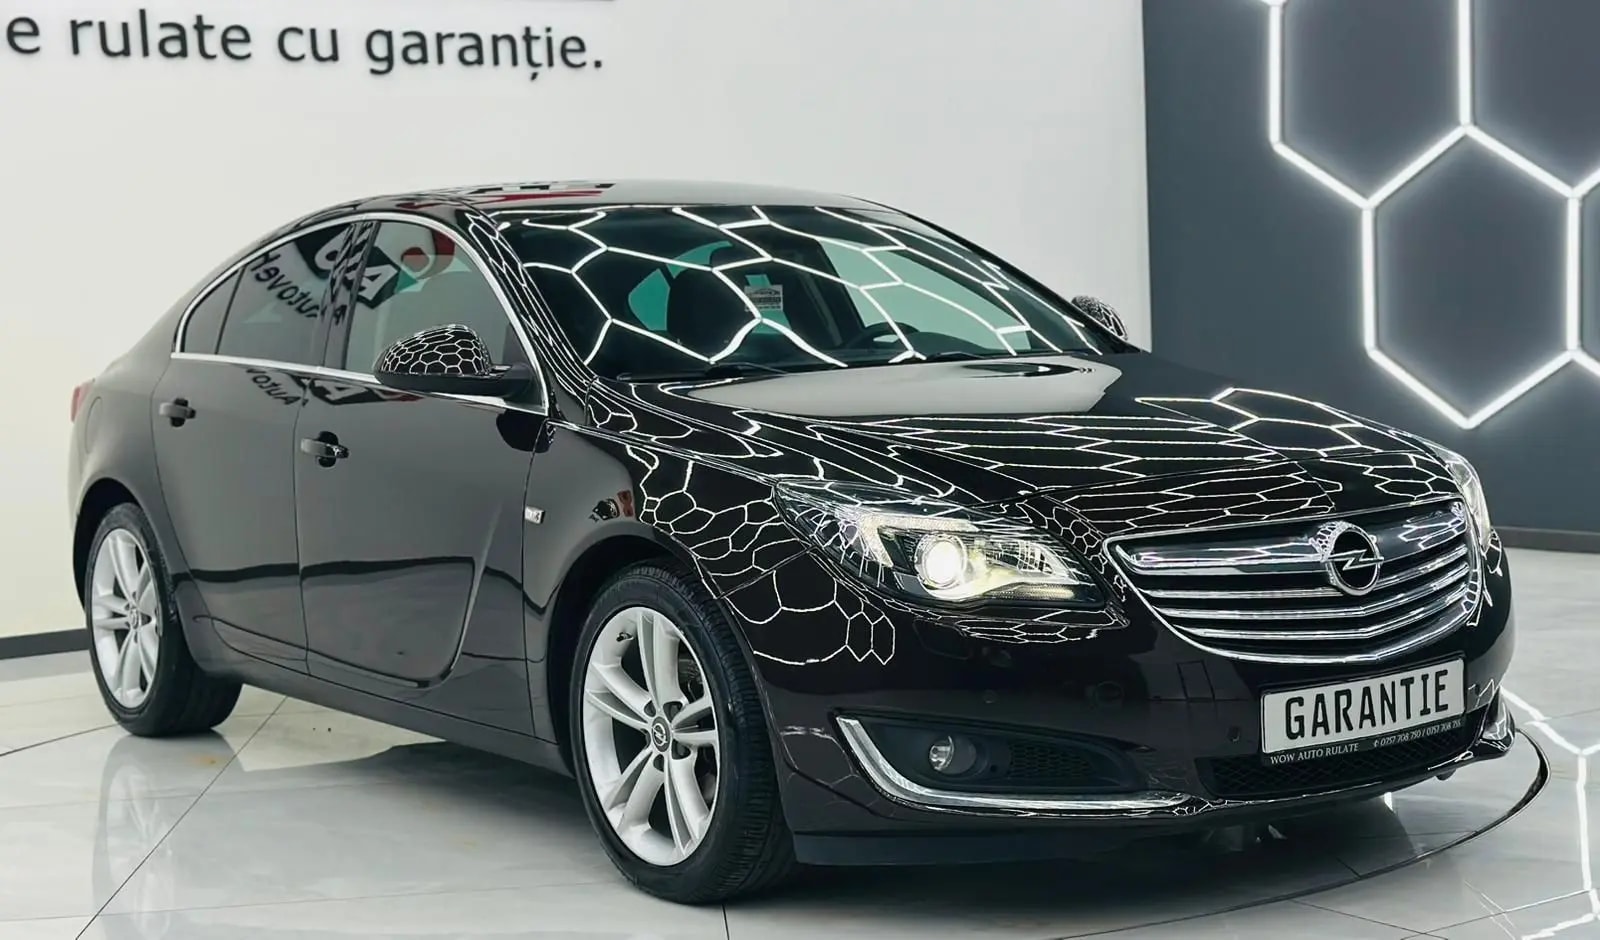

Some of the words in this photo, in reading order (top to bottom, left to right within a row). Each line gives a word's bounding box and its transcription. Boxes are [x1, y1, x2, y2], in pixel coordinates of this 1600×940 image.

[6, 16, 41, 55] e
[69, 9, 252, 60] rulate
[277, 25, 340, 63] cu
[365, 26, 603, 80] garanție.
[1285, 669, 1449, 740] GARANTIE
[1270, 753, 1295, 765] WOW
[1297, 749, 1323, 761] AUTO
[1325, 743, 1360, 756] RULATE
